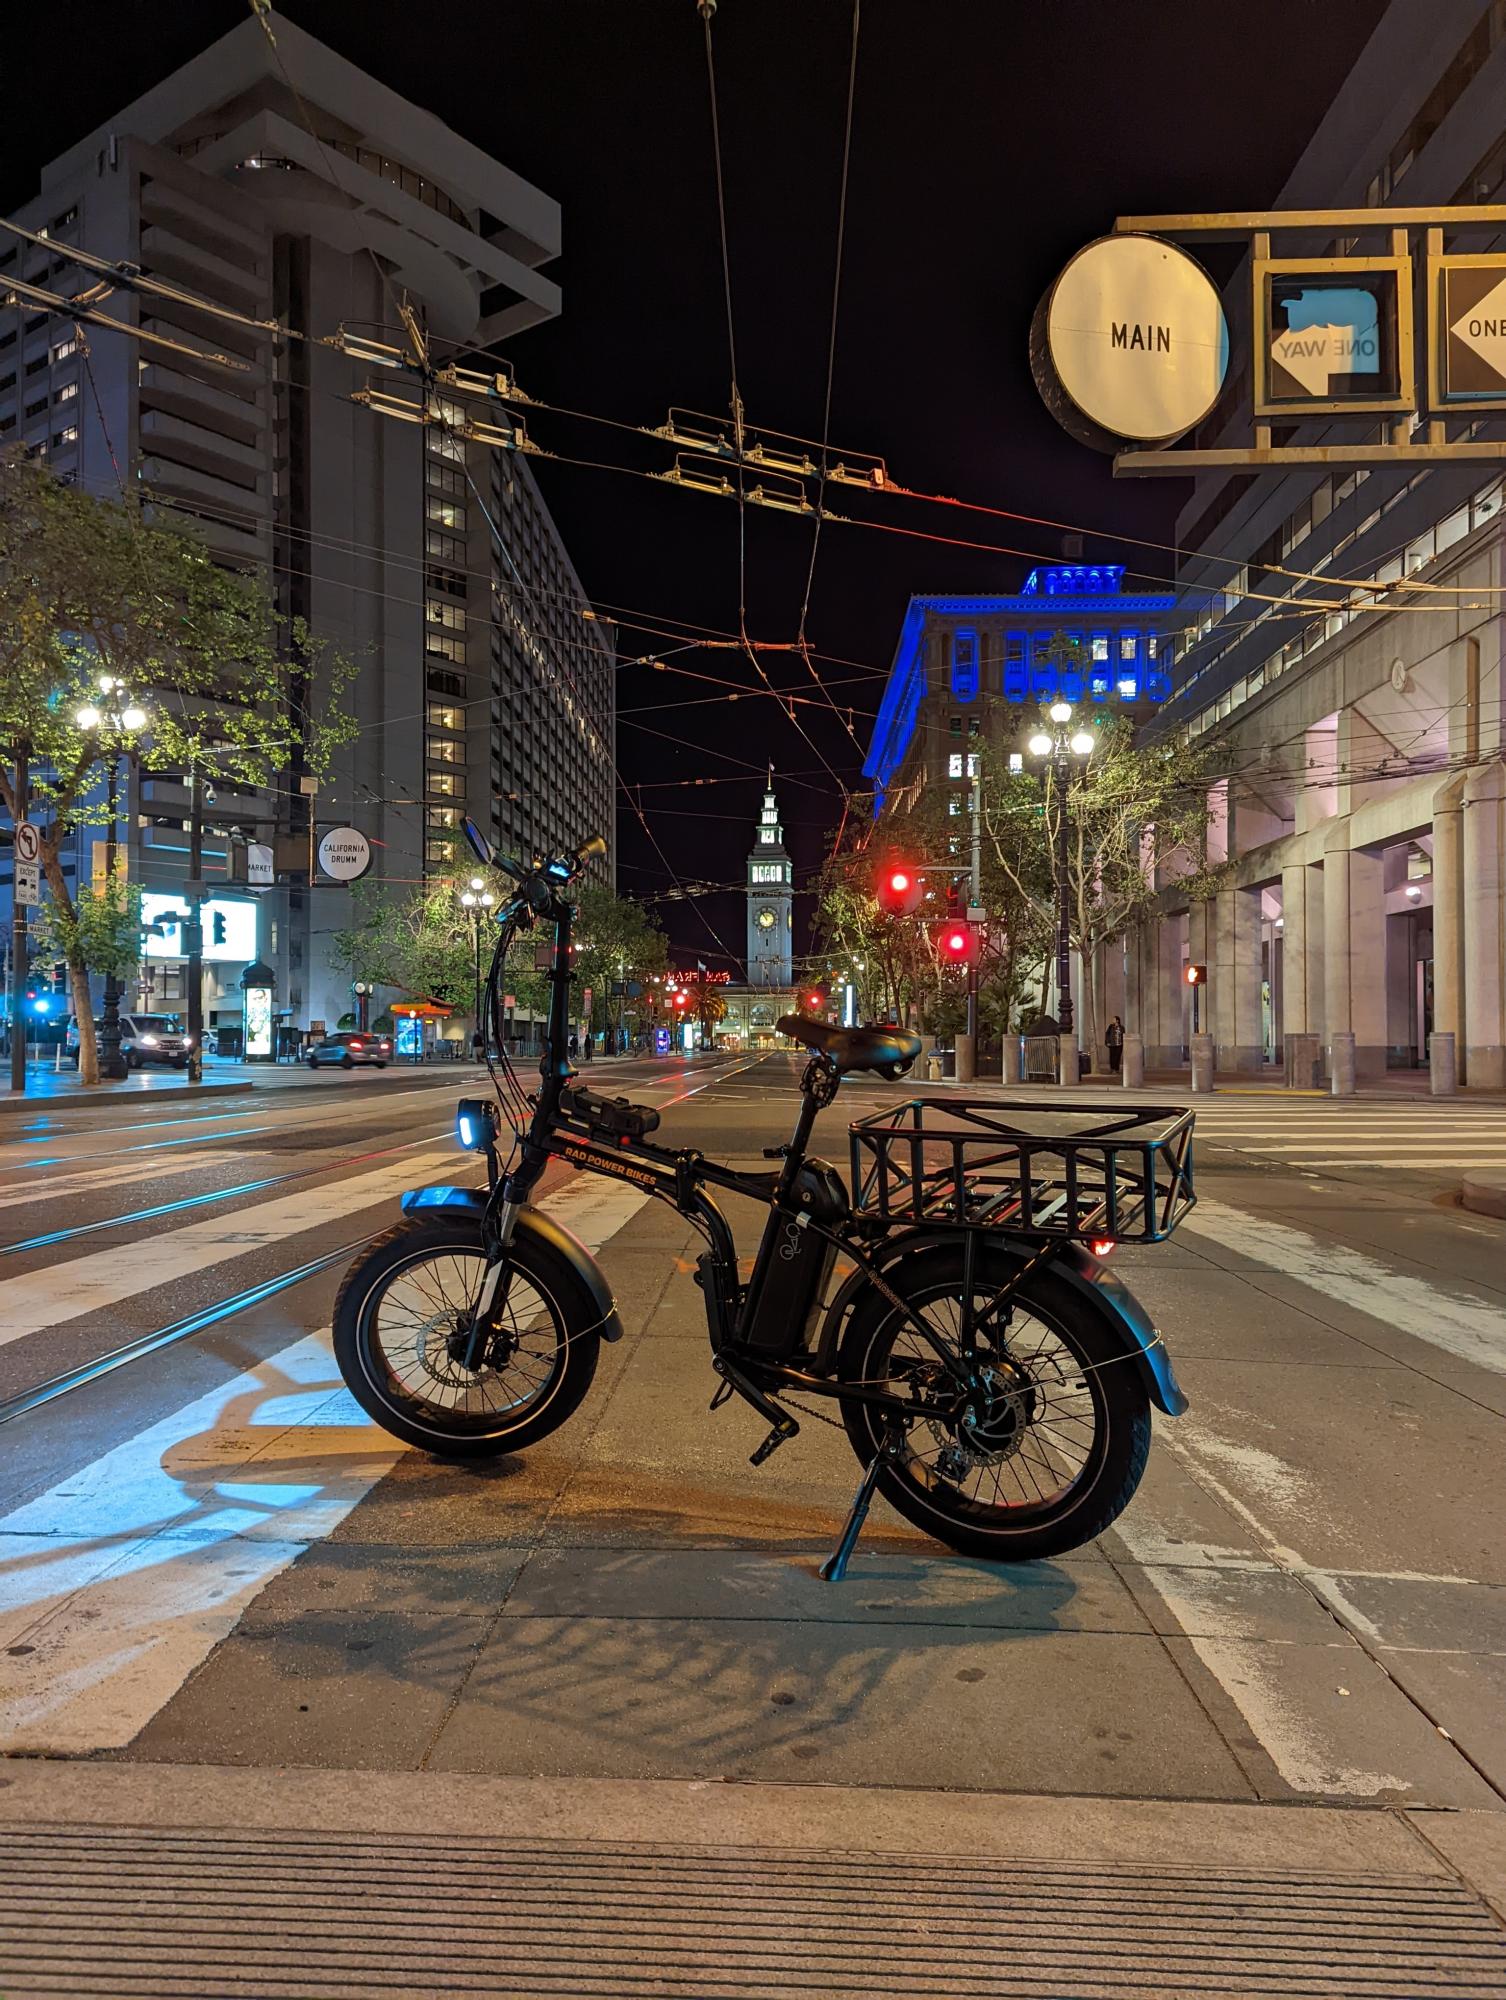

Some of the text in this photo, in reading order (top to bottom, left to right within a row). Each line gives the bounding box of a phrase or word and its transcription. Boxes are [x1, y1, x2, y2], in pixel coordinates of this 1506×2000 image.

[1469, 319, 1506, 337] ONE
[1111, 322, 1170, 353] MAIN
[323, 844, 365, 853] CALIFORNIA
[331, 855, 357, 864] DRUMM
[29, 925, 50, 935] MARKET
[565, 1147, 657, 1186] RAD POWER BIKES
